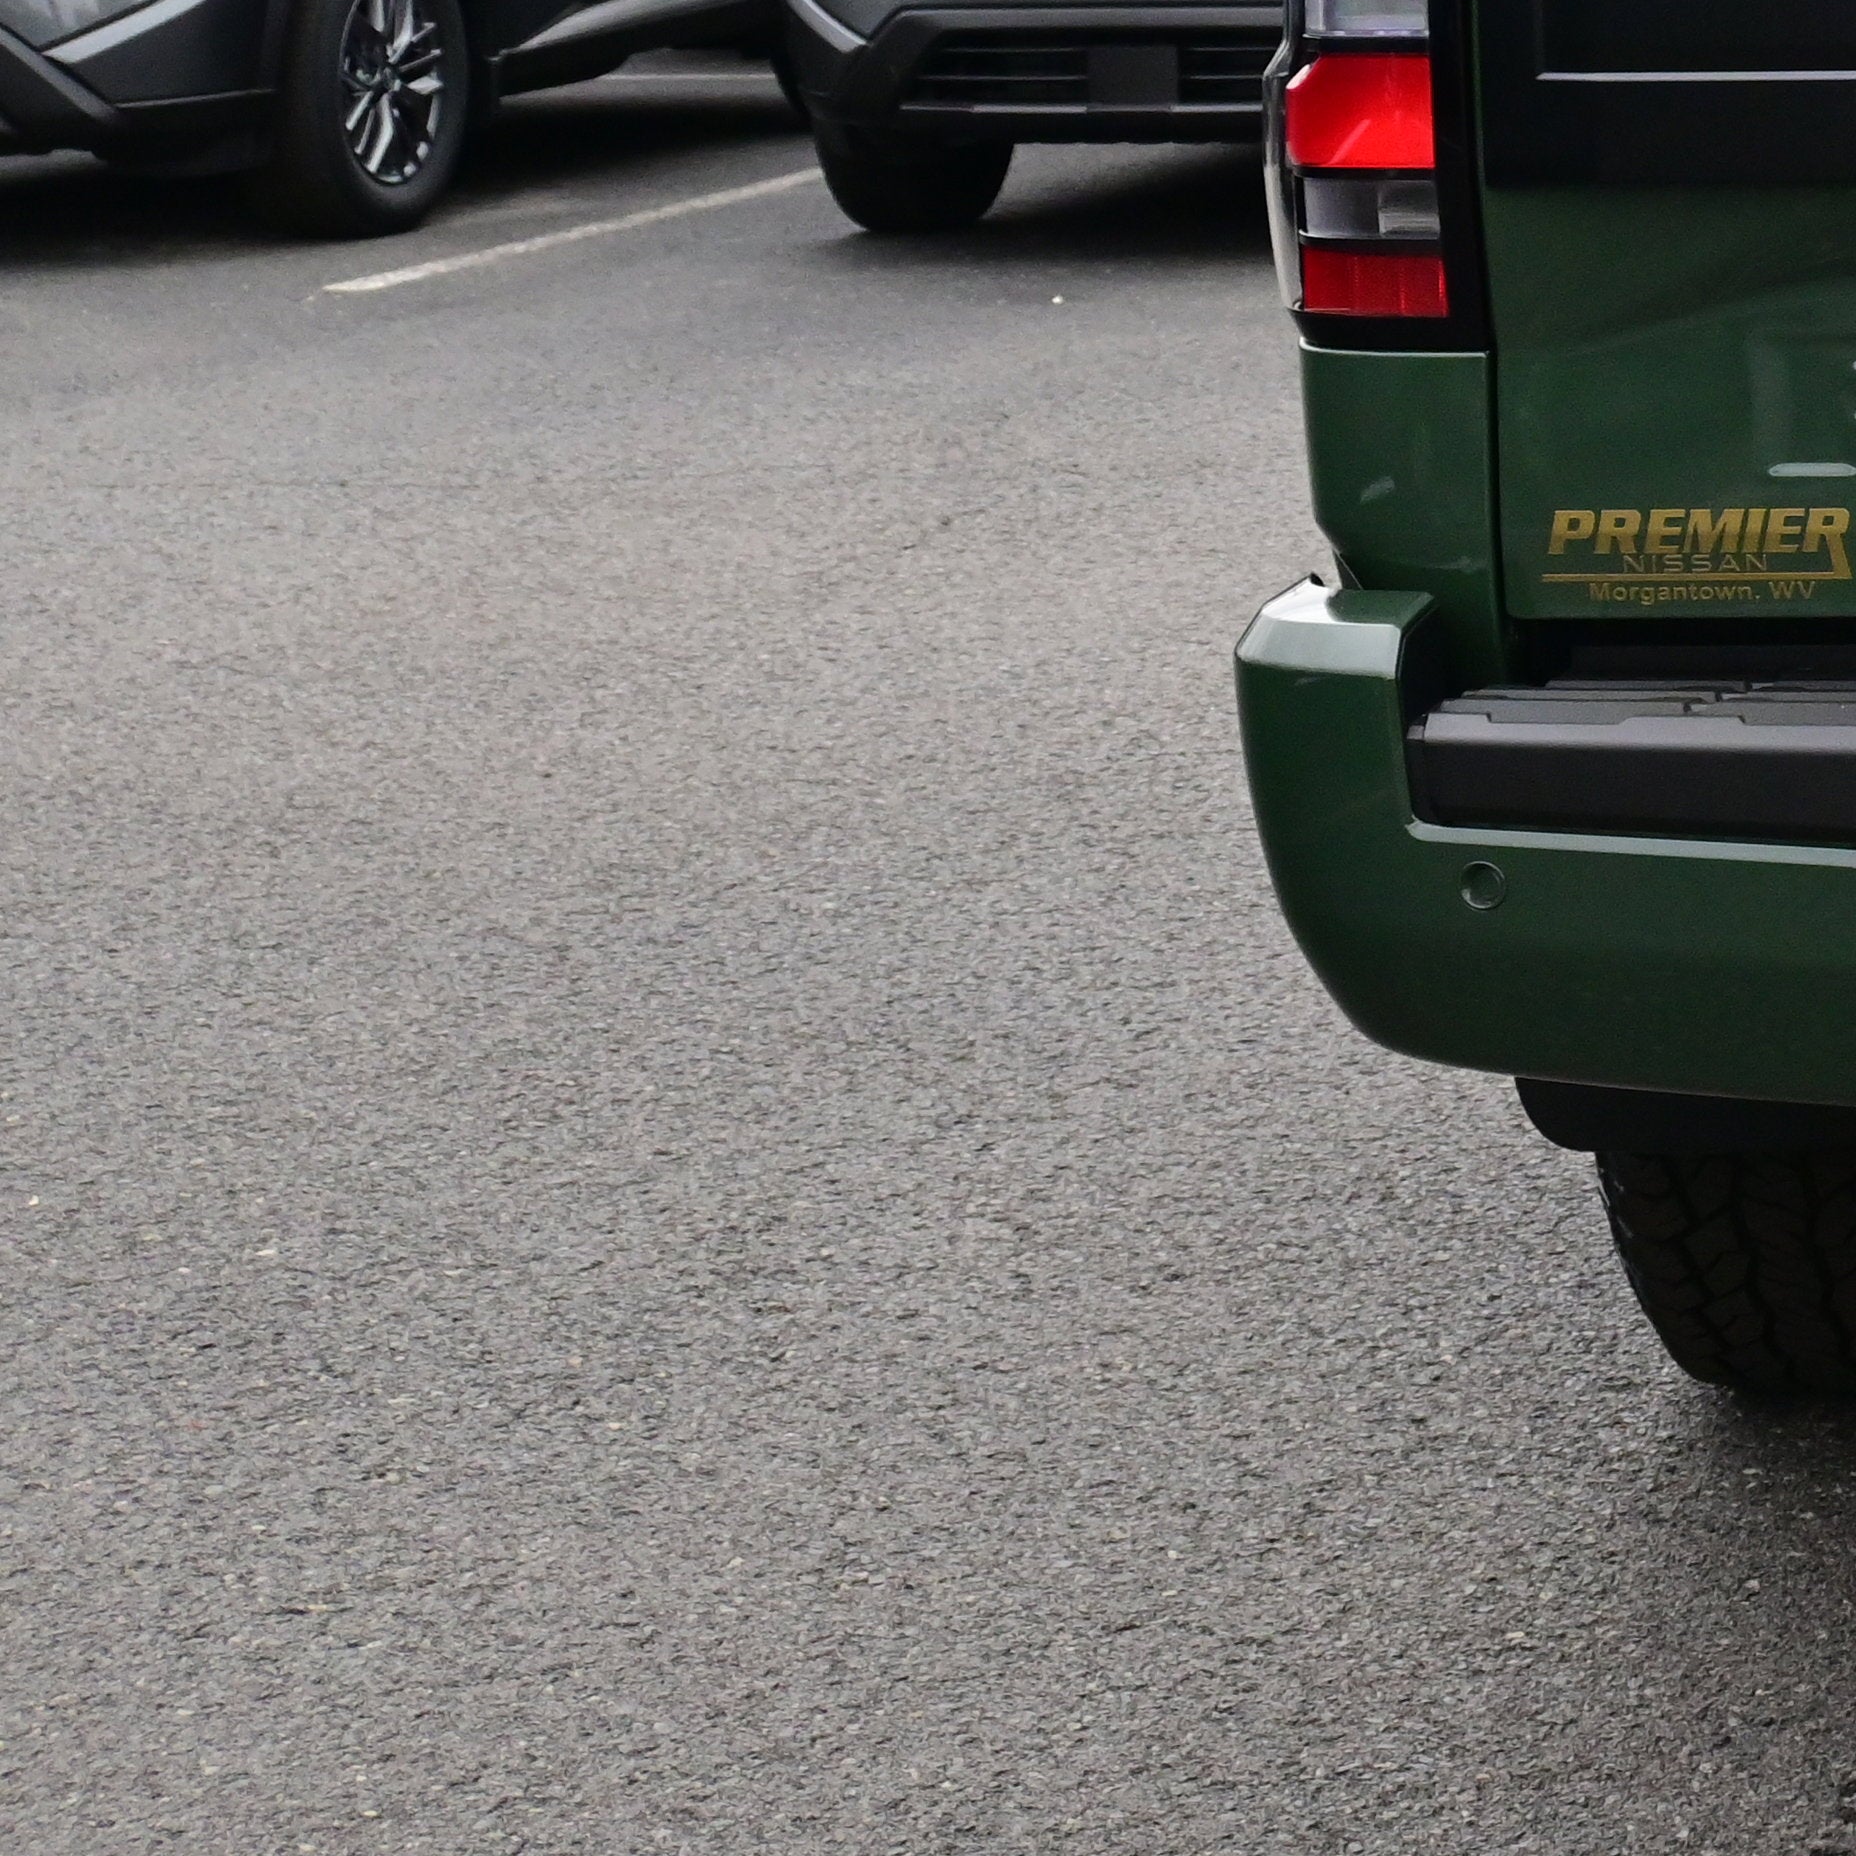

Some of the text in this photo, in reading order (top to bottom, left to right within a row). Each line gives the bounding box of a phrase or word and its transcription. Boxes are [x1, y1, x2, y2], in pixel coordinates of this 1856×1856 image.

[1547, 507, 1853, 578] PREMIER
[1622, 554, 1768, 573] NISSAN
[1769, 581, 1816, 600] WV
